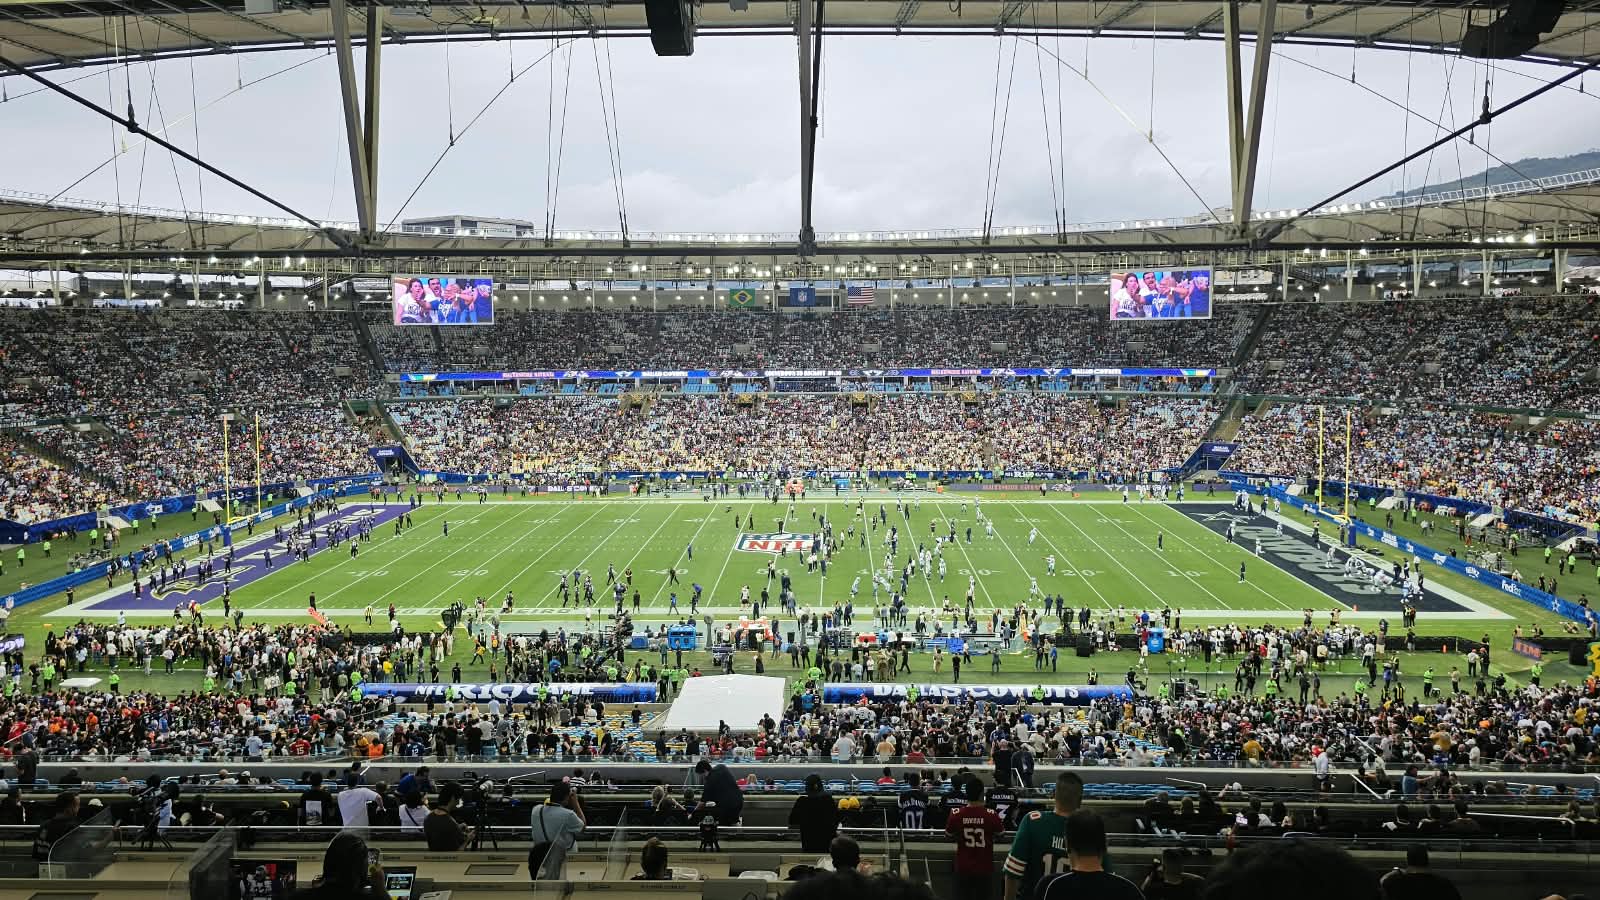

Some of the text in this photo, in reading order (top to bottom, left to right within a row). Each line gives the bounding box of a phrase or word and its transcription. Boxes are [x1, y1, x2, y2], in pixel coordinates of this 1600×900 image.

[748, 540, 813, 551] NFL
[1501, 579, 1522, 598] FedEx
[415, 685, 447, 696] NFL
[449, 684, 524, 700] RIO
[873, 685, 1080, 699] DALAS COWOYS
[296, 747, 305, 755] 15
[963, 827, 986, 848] 53
[1051, 835, 1069, 851] HIL
